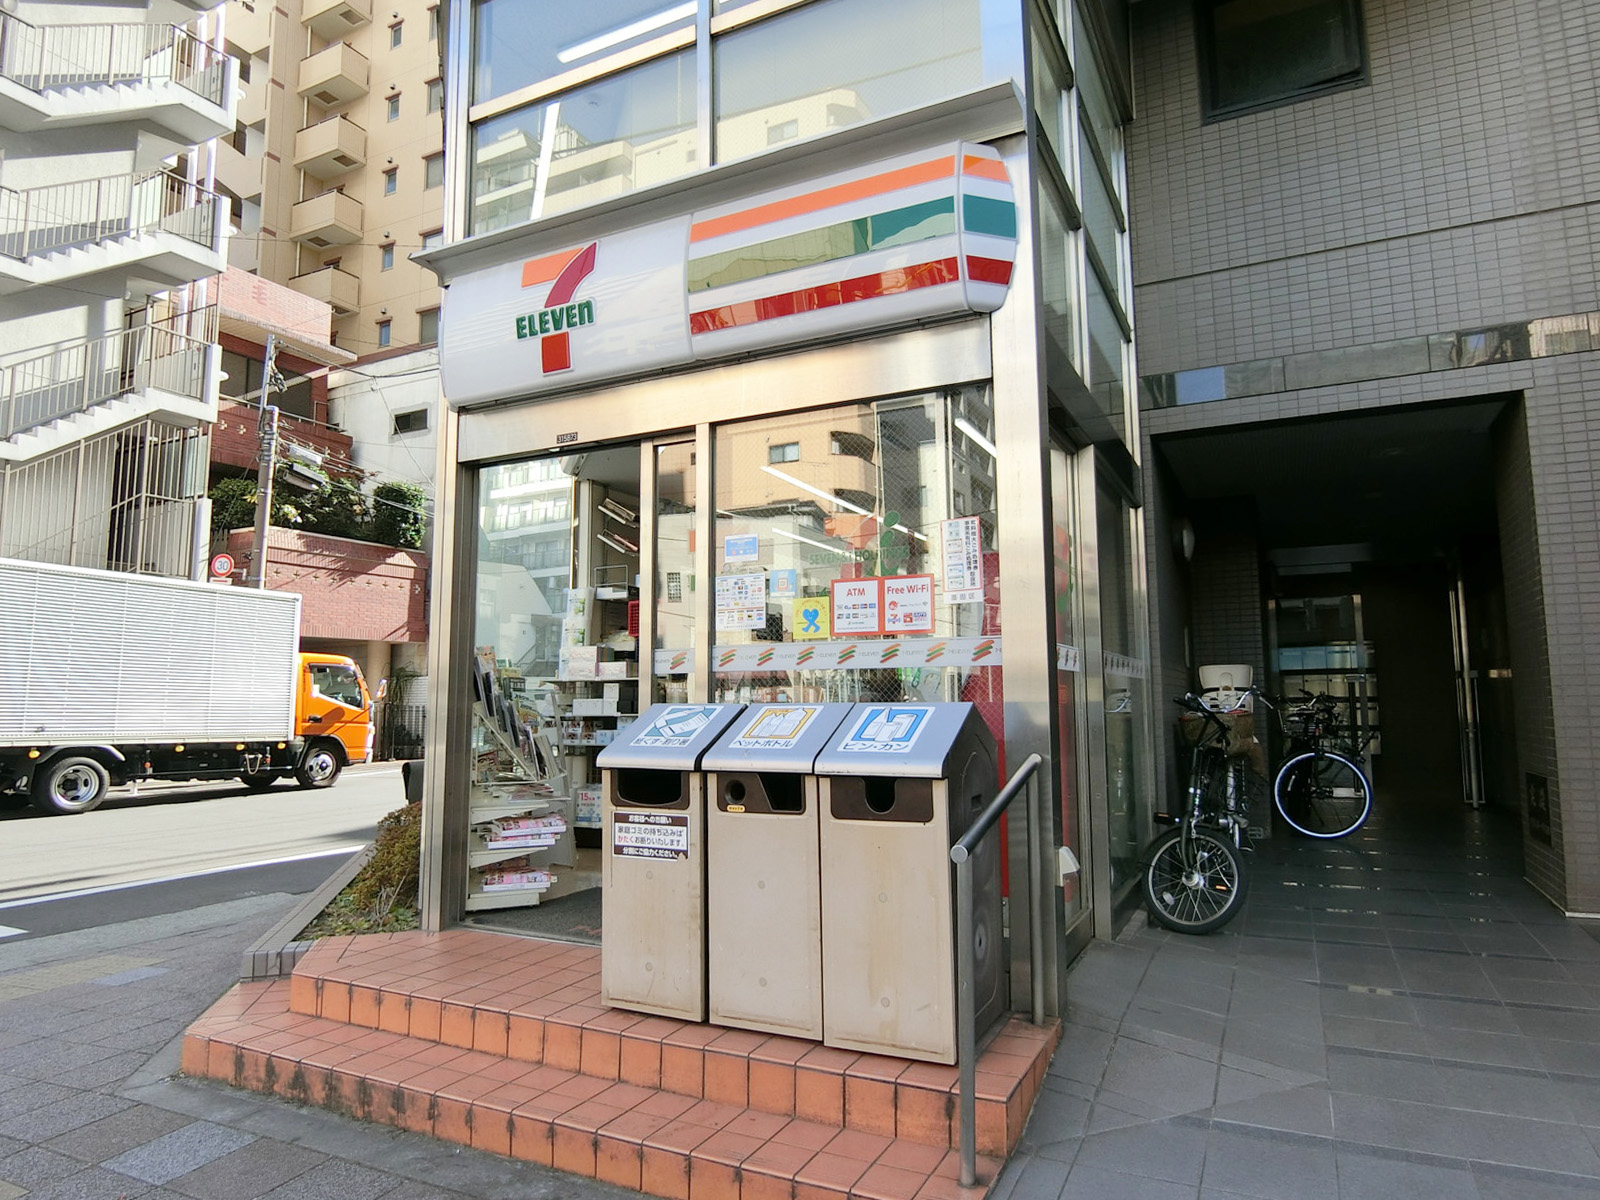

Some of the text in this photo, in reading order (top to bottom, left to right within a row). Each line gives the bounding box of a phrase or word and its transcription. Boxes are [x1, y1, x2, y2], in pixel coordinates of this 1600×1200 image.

[217, 560, 228, 571] 30
[847, 587, 865, 597] ATM
[887, 583, 929, 595] Free Wi-Fi
[732, 738, 793, 748] ペットボトル
[843, 741, 909, 751] ビン・カン
[628, 814, 672, 824] お客様へのお願い
[617, 835, 685, 848] かたくお断りいたします。
